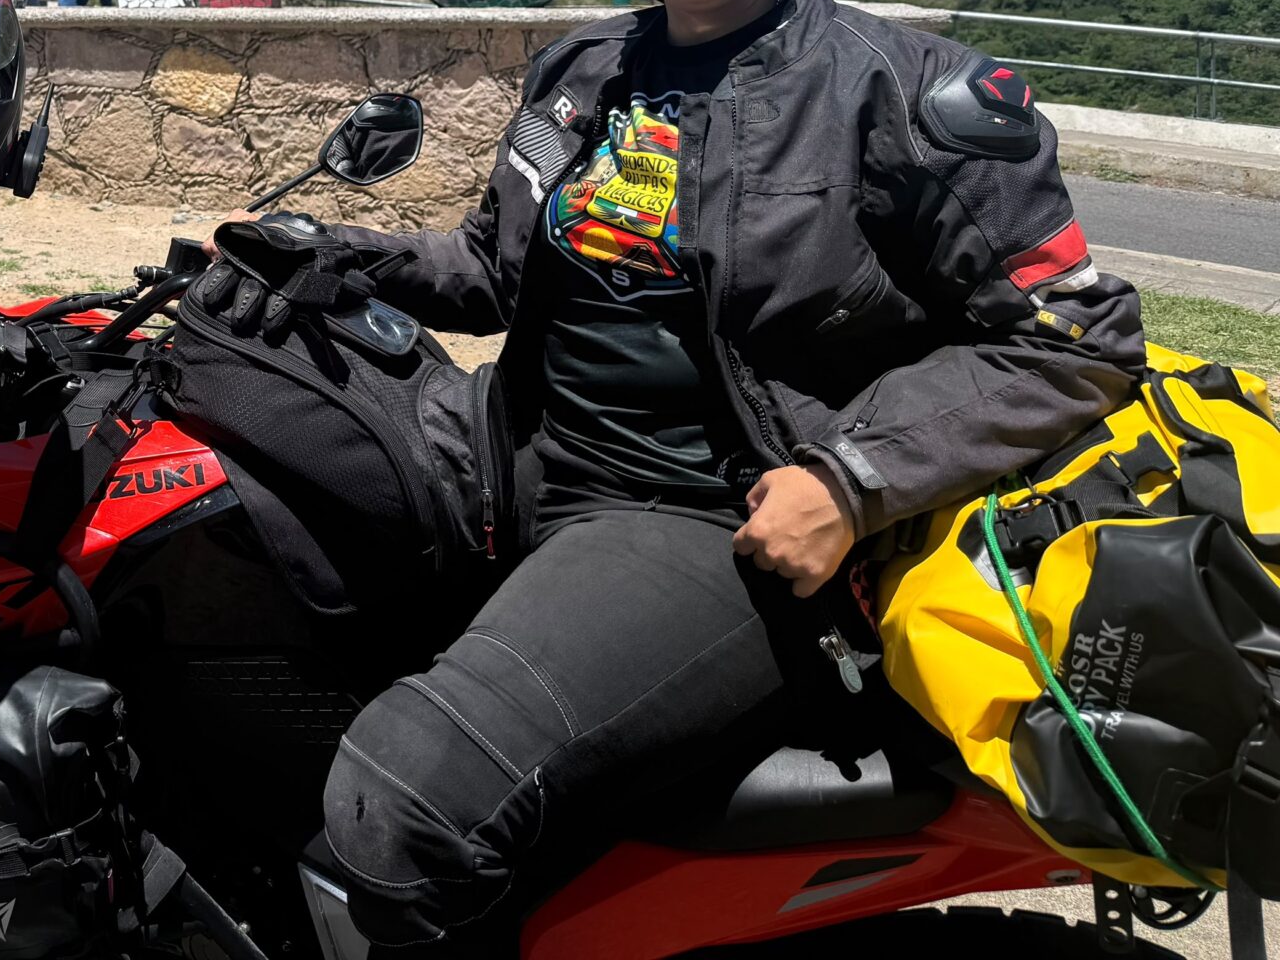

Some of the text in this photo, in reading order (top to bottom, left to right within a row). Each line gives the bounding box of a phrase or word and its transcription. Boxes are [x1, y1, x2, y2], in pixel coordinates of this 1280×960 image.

[106, 462, 206, 499] ZUKI
[1090, 618, 1127, 686] PACK
[1101, 632, 1145, 740] TRAVEL WITH US
